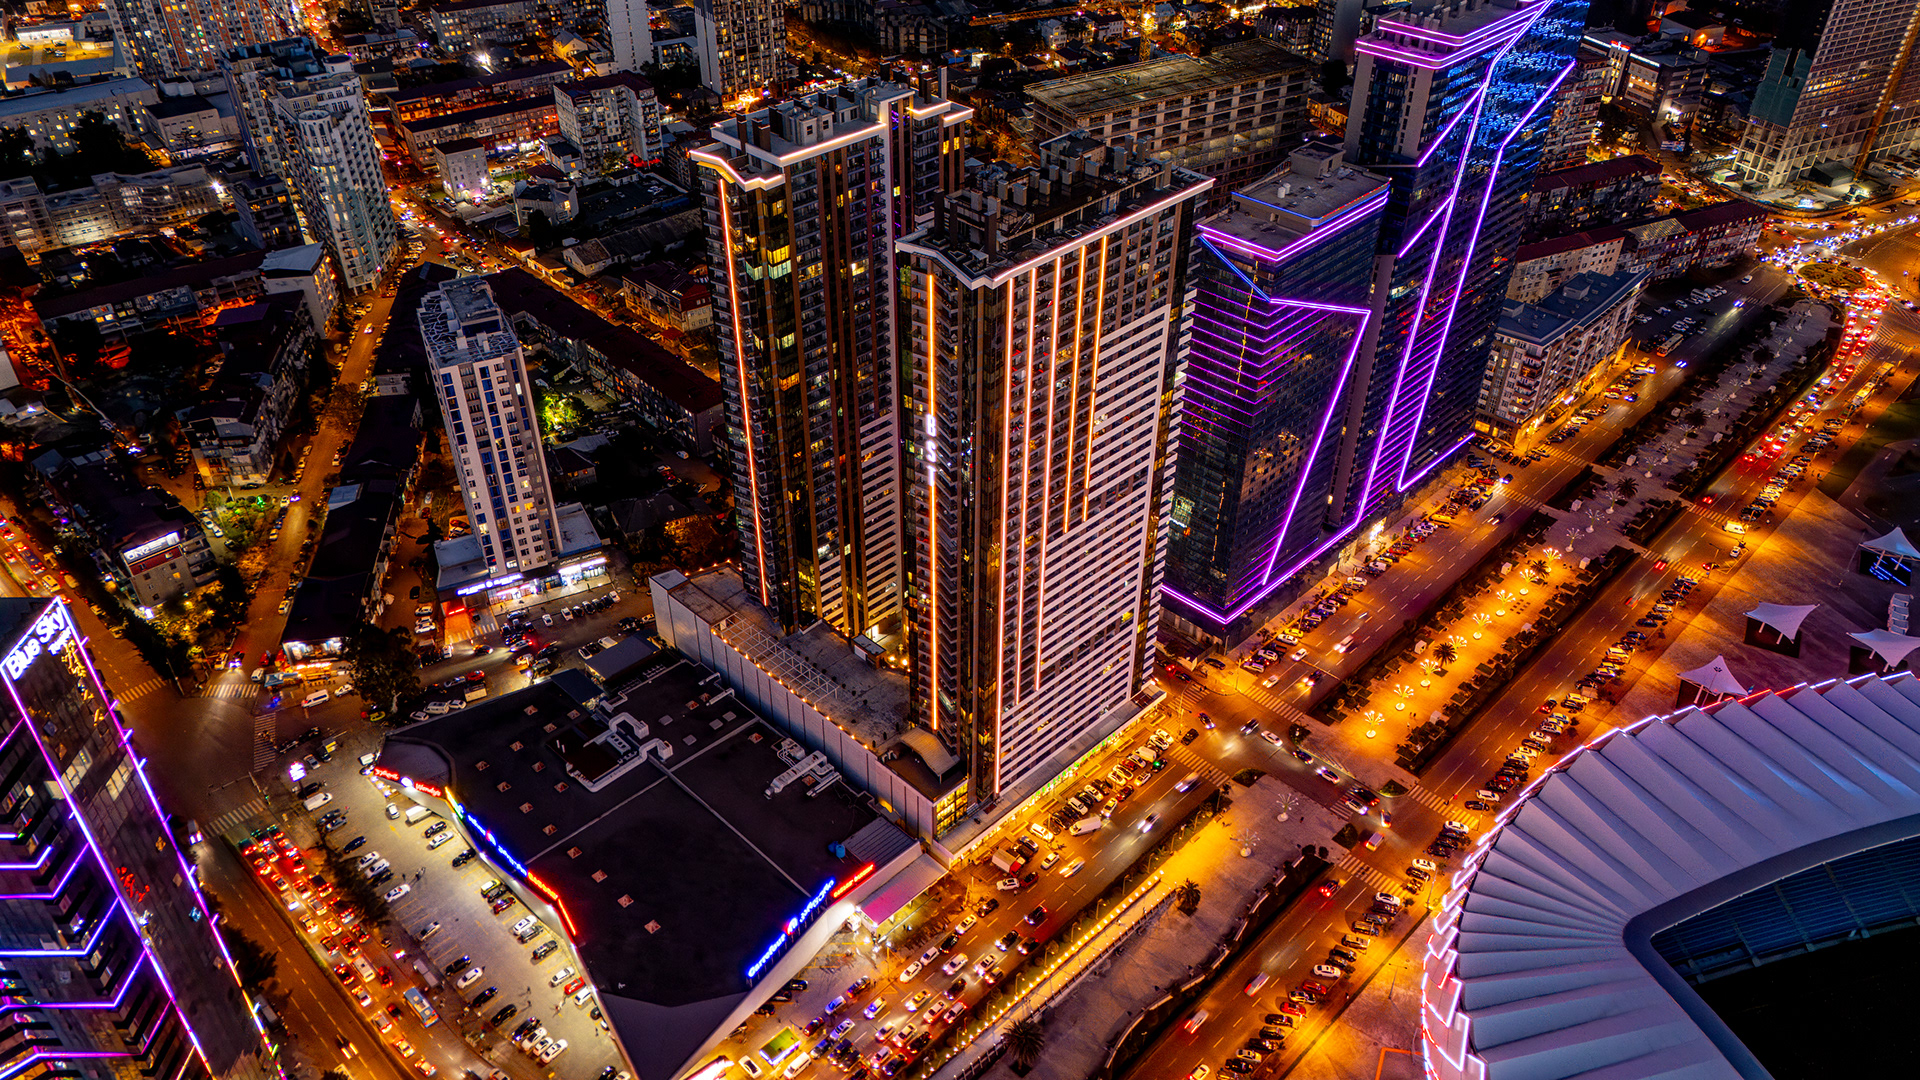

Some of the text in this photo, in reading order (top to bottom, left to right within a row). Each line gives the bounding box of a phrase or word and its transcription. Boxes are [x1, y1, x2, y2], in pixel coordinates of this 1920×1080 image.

[5, 606, 66, 681] Blue Sky
[747, 932, 786, 978] Carrefour
